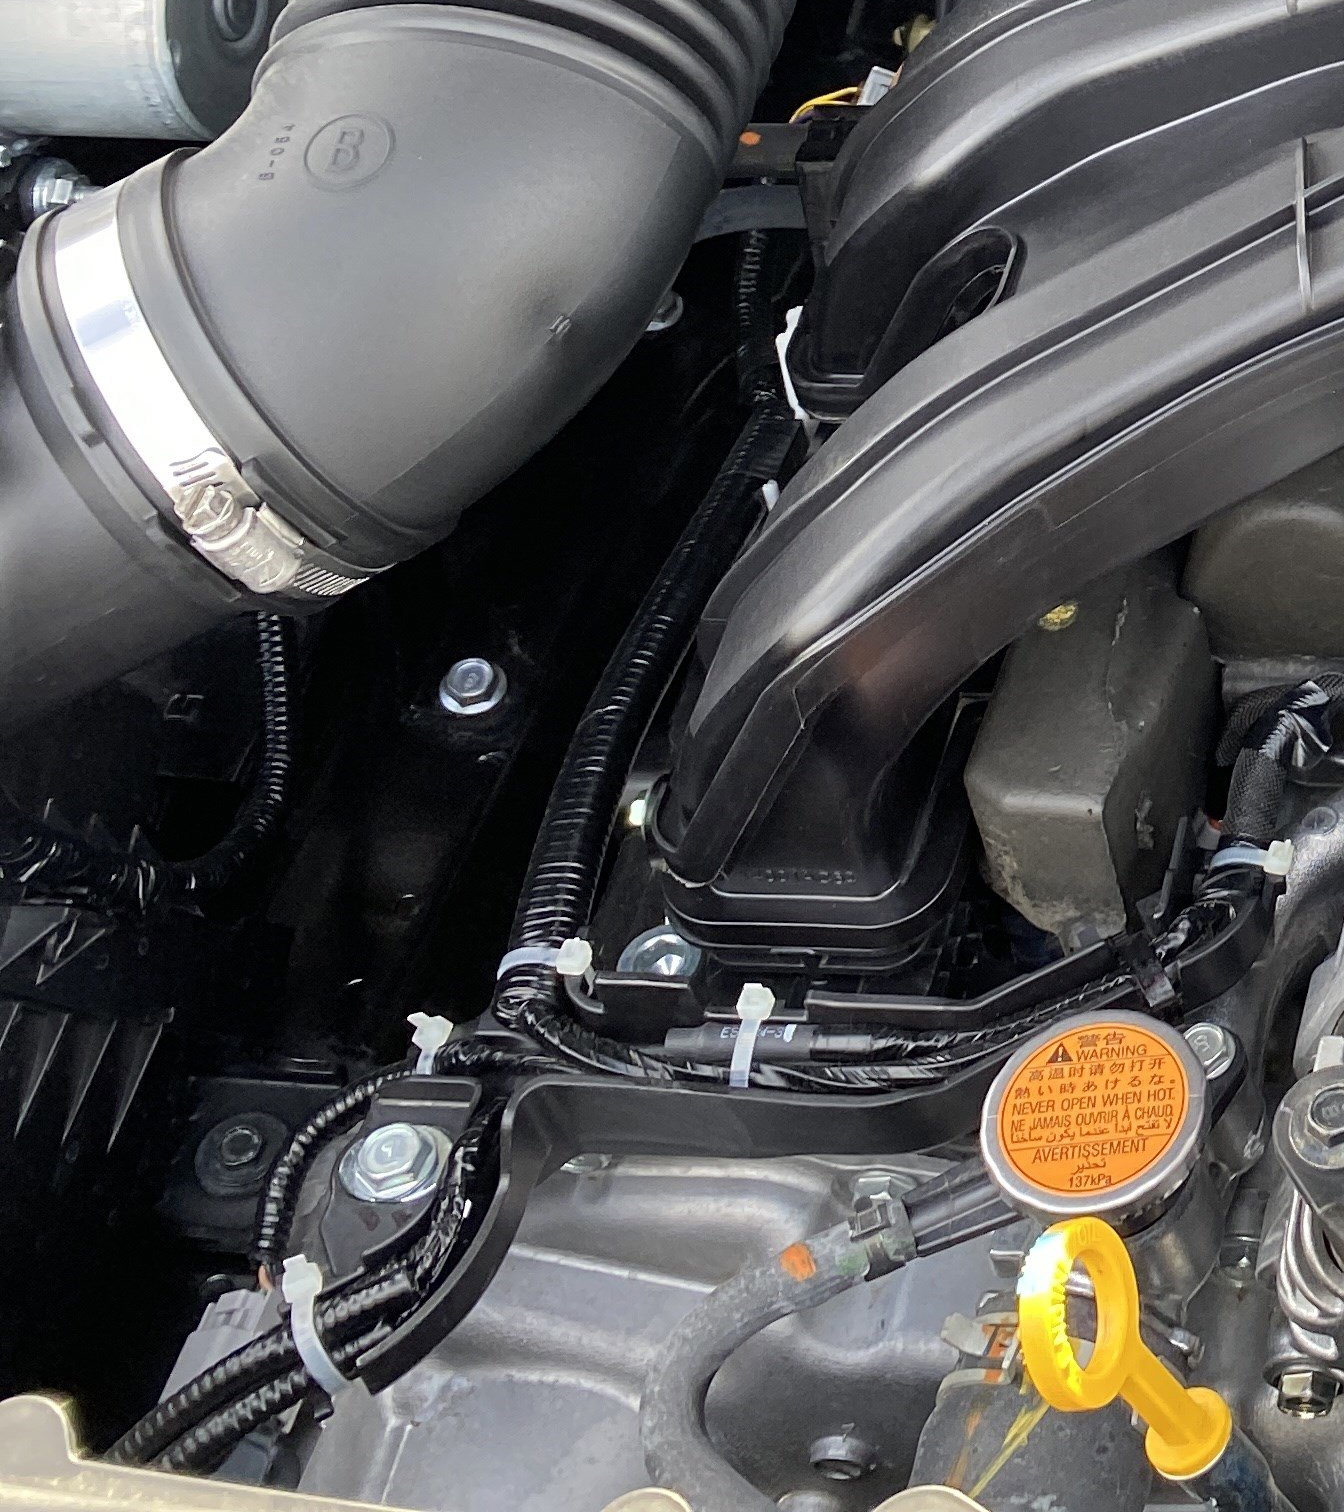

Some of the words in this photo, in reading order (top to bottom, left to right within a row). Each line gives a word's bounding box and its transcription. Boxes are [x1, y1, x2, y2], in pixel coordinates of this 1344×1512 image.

[326, 128, 366, 172] B
[1078, 1031, 1126, 1049] 警告
[1076, 1044, 1147, 1062] WARNING
[1012, 1100, 1055, 1116] NEVER
[1061, 1096, 1097, 1110] OPEN
[1102, 1092, 1141, 1106] WHEN
[1147, 1088, 1176, 1101] HOT.
[1011, 1119, 1026, 1133] NE
[1029, 1114, 1072, 1130] JAMAIS
[1075, 1109, 1119, 1126] OUVRIR
[1122, 1105, 1131, 1121] À
[1136, 1119, 1160, 1136] تفتح
[1164, 1118, 1173, 1130] لا
[1046, 1128, 1076, 1144] يكون
[1032, 1138, 1149, 1165] AVERTISSEMENT
[1071, 1158, 1107, 1176] تحذير
[1069, 1174, 1112, 1189] 137kPa
